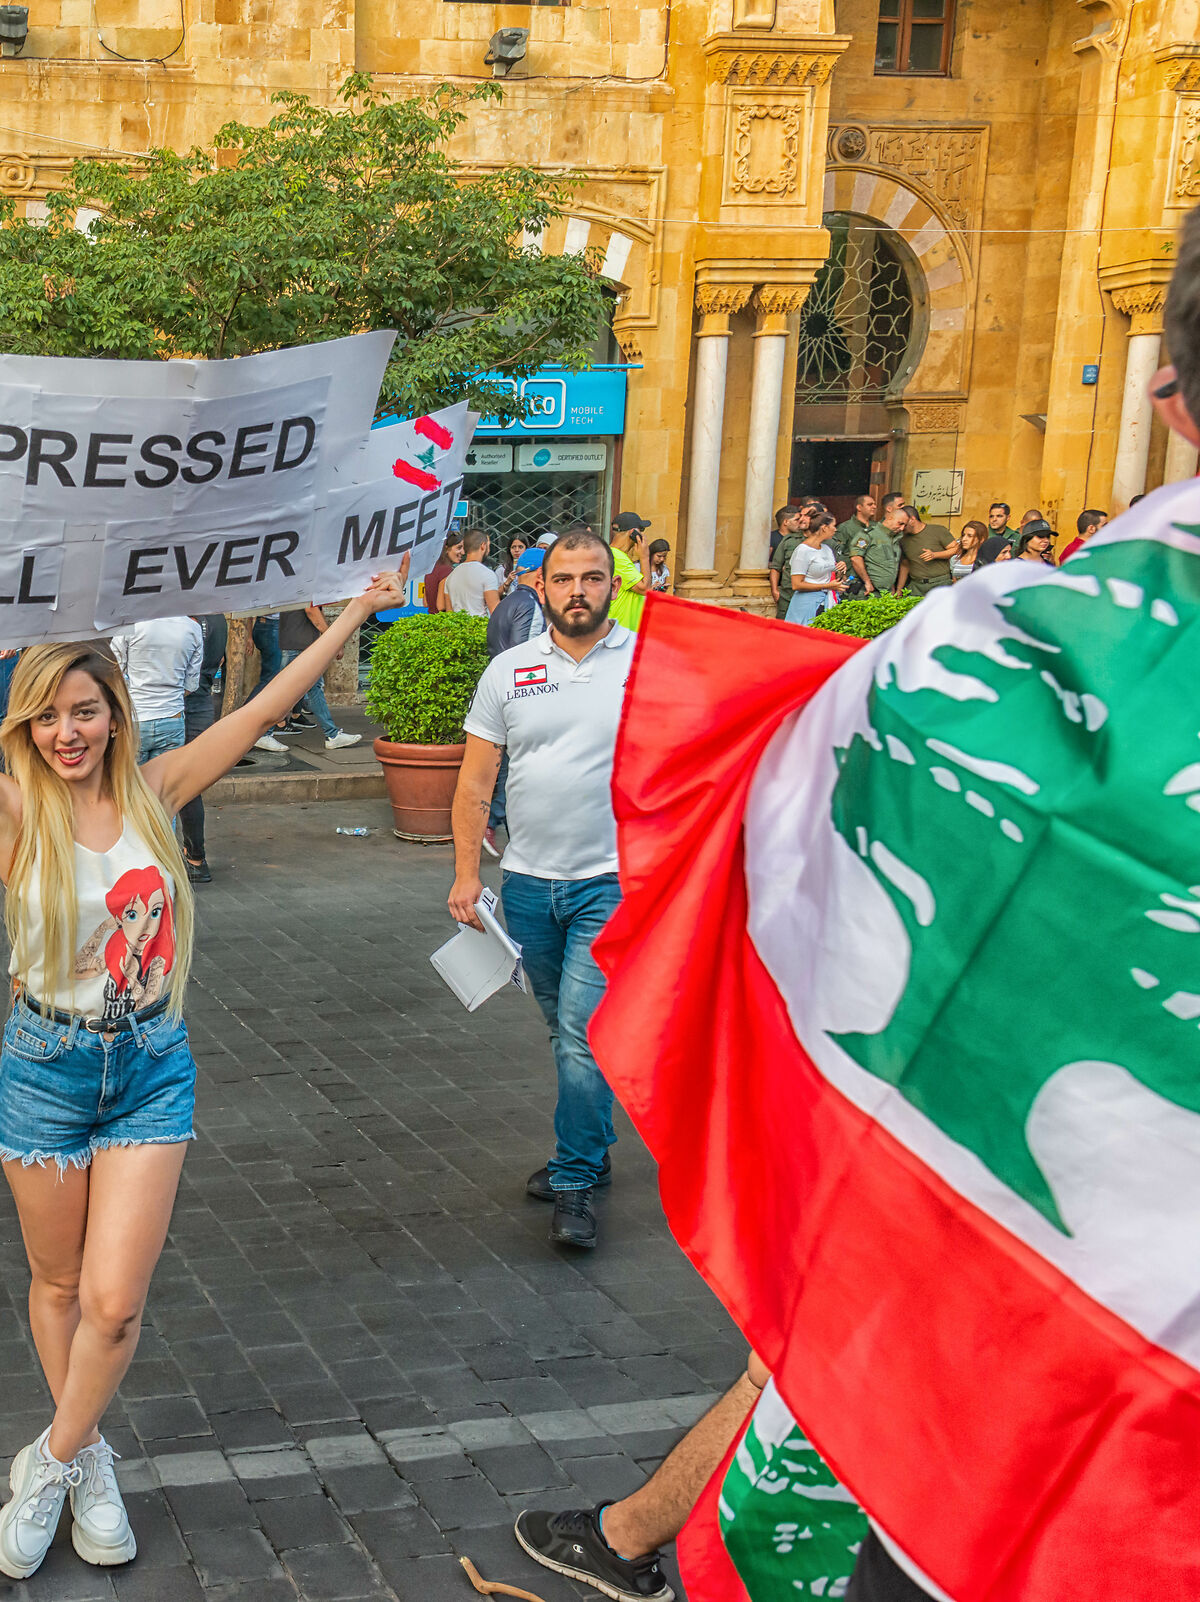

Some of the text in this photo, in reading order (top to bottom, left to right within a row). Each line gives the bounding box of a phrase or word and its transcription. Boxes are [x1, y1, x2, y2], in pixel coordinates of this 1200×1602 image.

[571, 406, 604, 415] MOBILE
[571, 416, 594, 425] TECH
[122, 530, 300, 596] EVER
[336, 478, 463, 565] MEET
[507, 683, 559, 700] LEBANON
